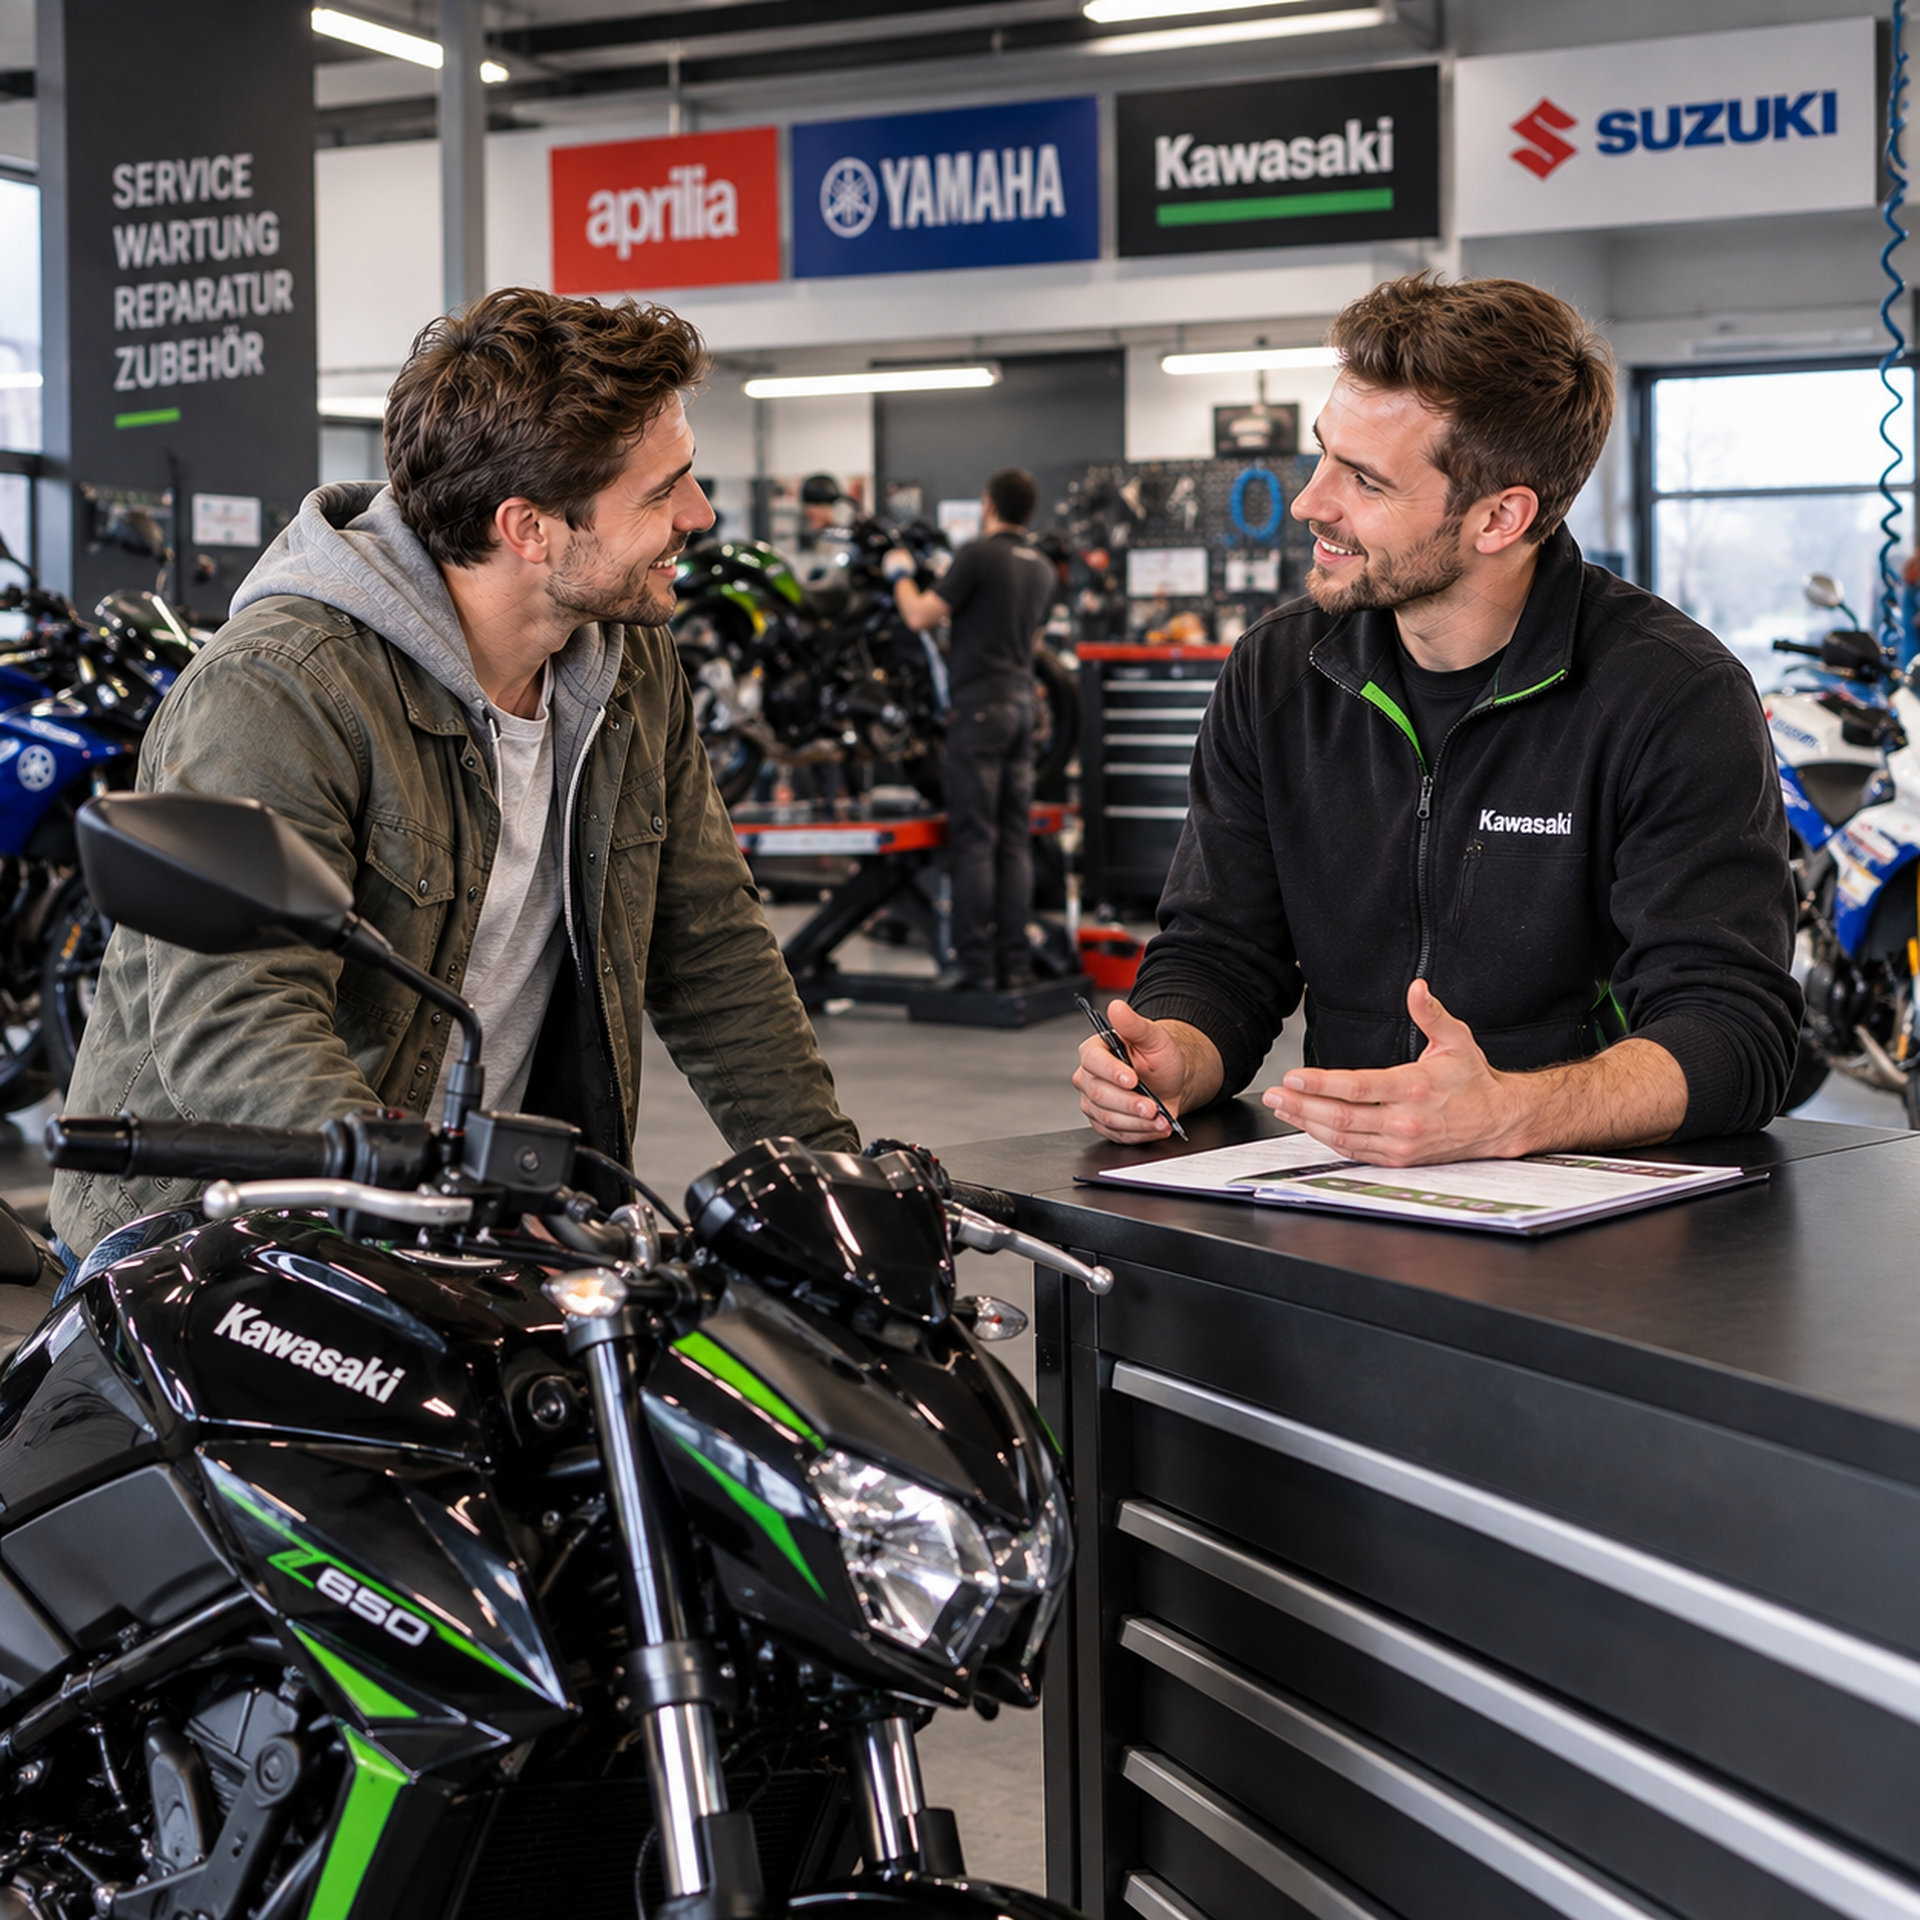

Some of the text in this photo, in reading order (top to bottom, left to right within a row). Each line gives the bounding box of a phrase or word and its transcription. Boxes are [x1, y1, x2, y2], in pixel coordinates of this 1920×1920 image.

[1155, 116, 1394, 190] Kawasaki
[1597, 90, 1838, 154] SUZUKI
[112, 152, 254, 209] SERVICE
[586, 164, 738, 261] aprilia
[880, 144, 1066, 231] YAMAHA
[112, 211, 281, 270] WARTUNG
[113, 269, 294, 331] REPARATUR
[113, 326, 265, 391] ZUBEHÖR
[1478, 808, 1573, 836] Kawasaki
[213, 1302, 406, 1404] Kawasaki
